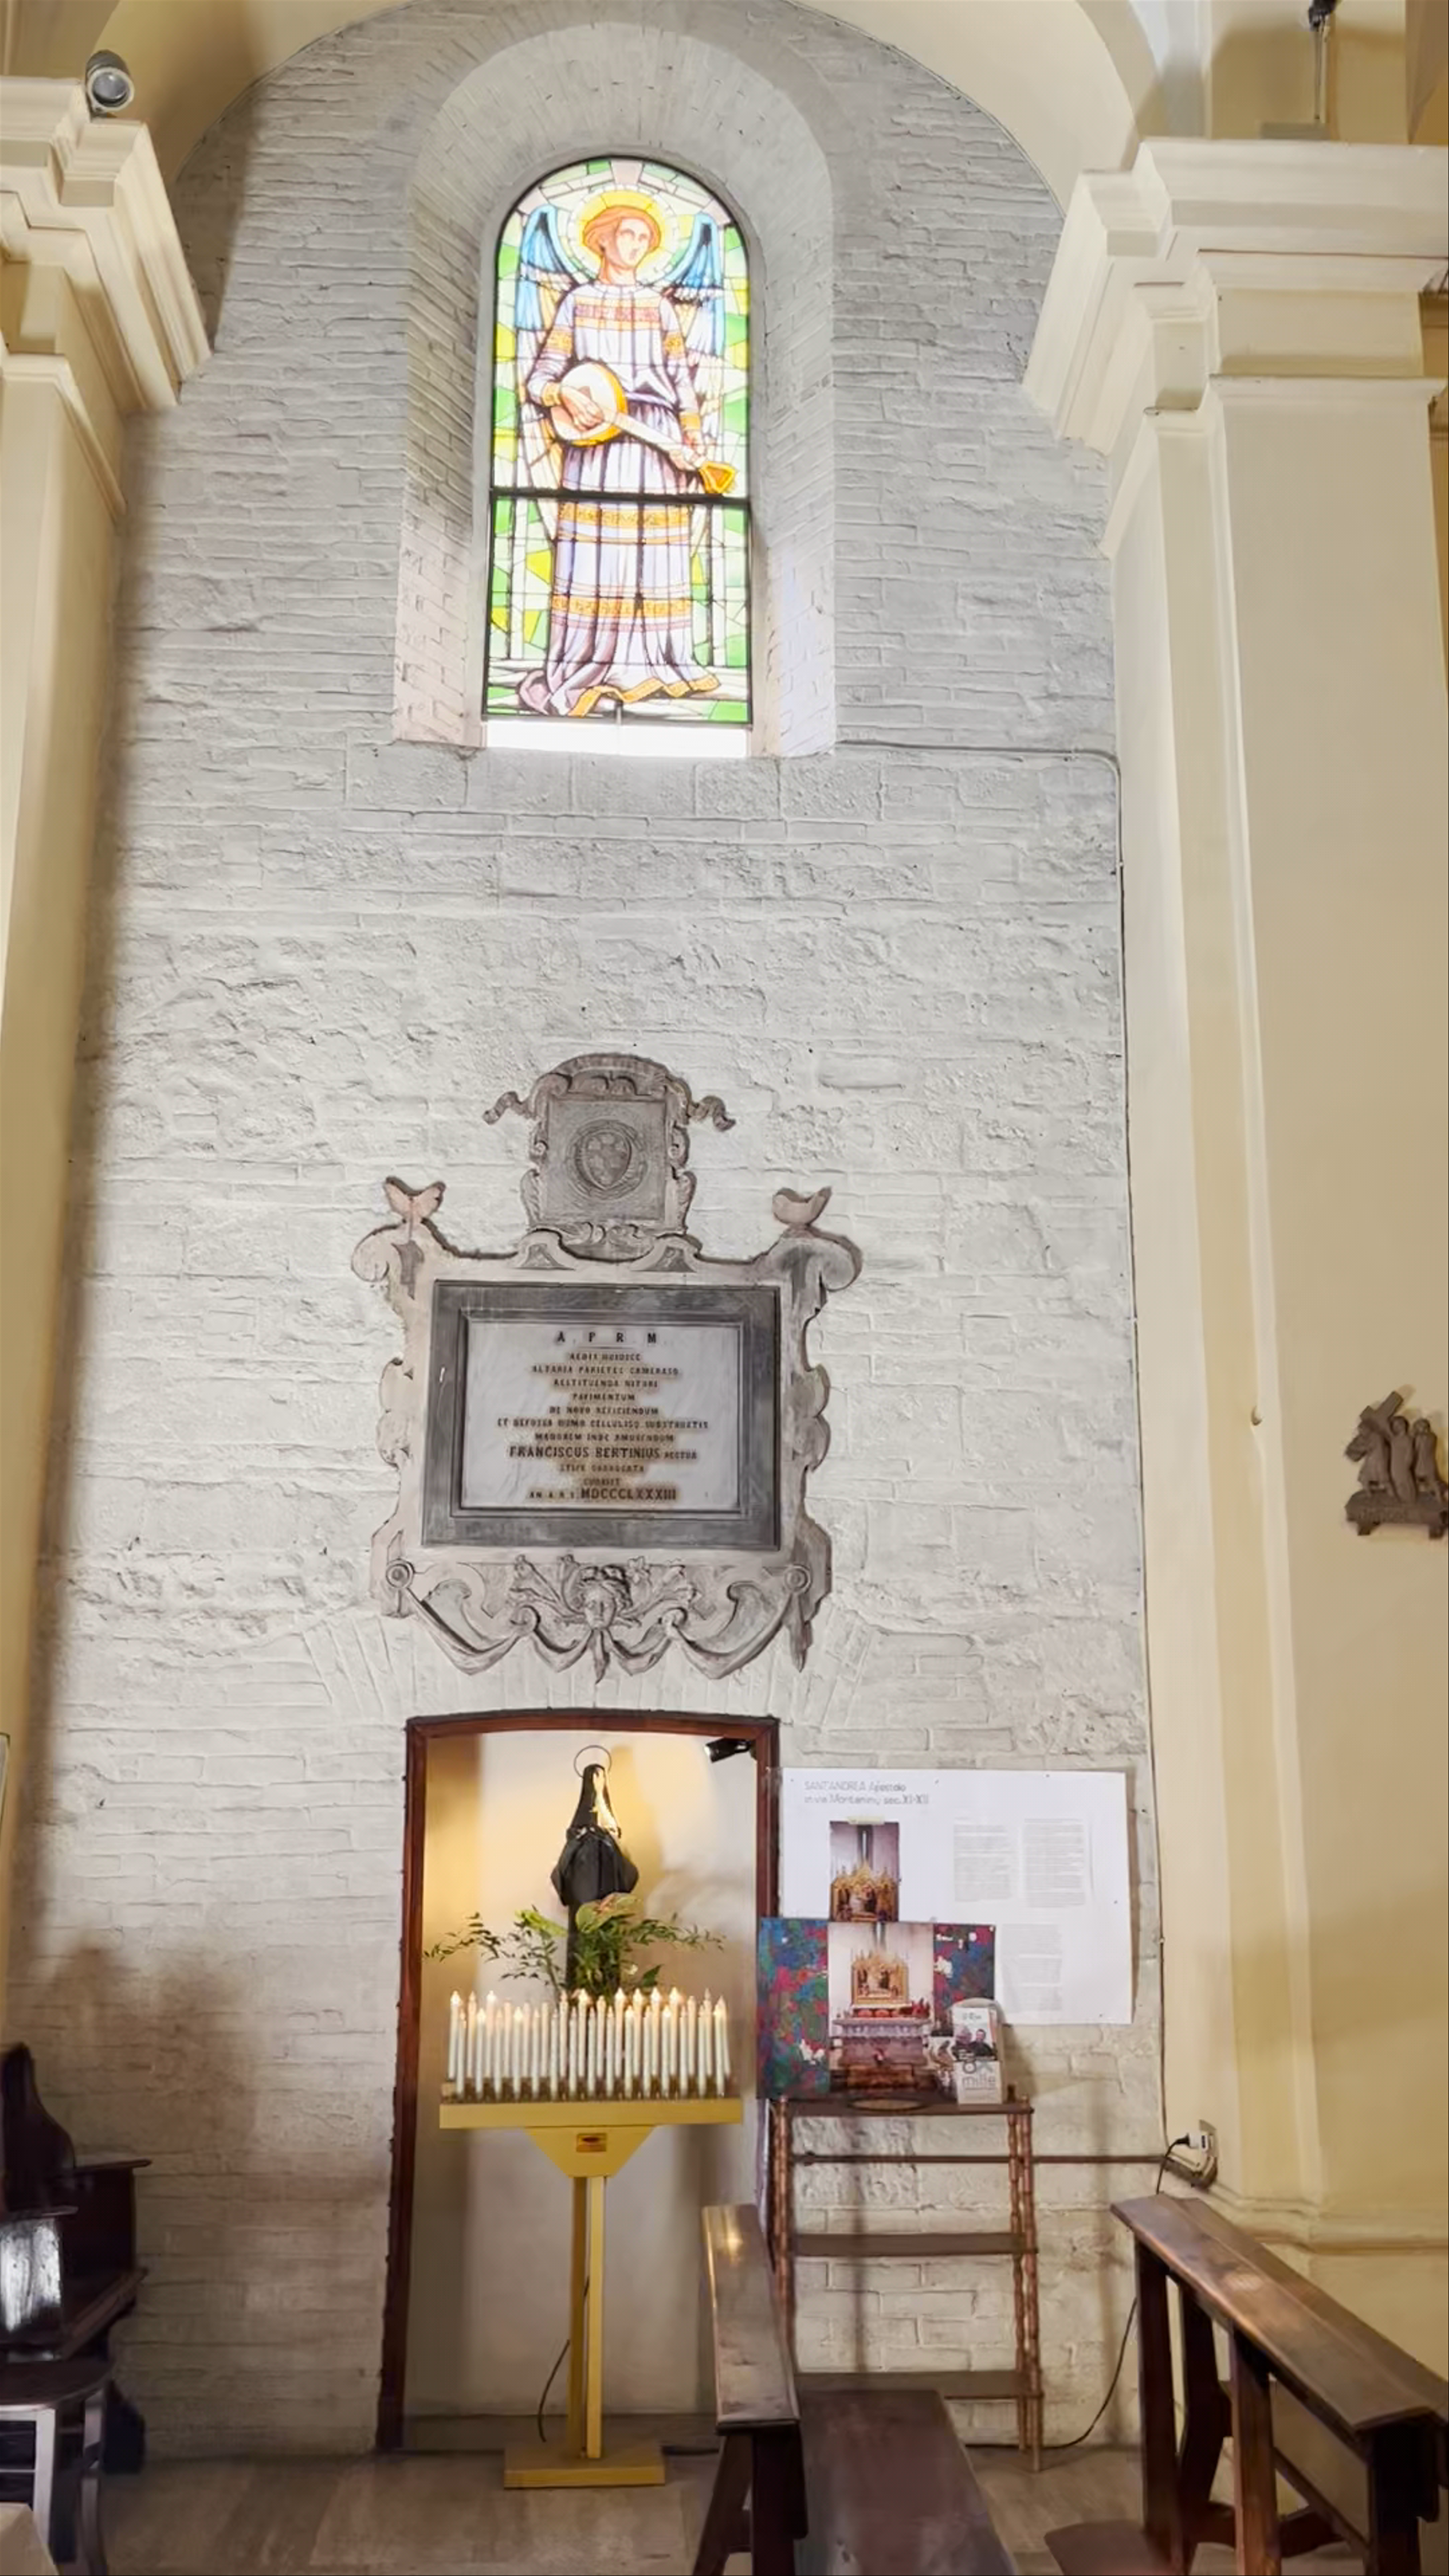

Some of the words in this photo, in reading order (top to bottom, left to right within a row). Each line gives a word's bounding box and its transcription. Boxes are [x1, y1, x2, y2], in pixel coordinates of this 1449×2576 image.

[549, 1406, 560, 1415] DE
[497, 1418, 508, 1427] ET
[509, 1446, 589, 1458] FRANCISCUS
[595, 1447, 660, 1459] BERTINIUS
[581, 1488, 677, 1501] MDCCCLXXXIII
